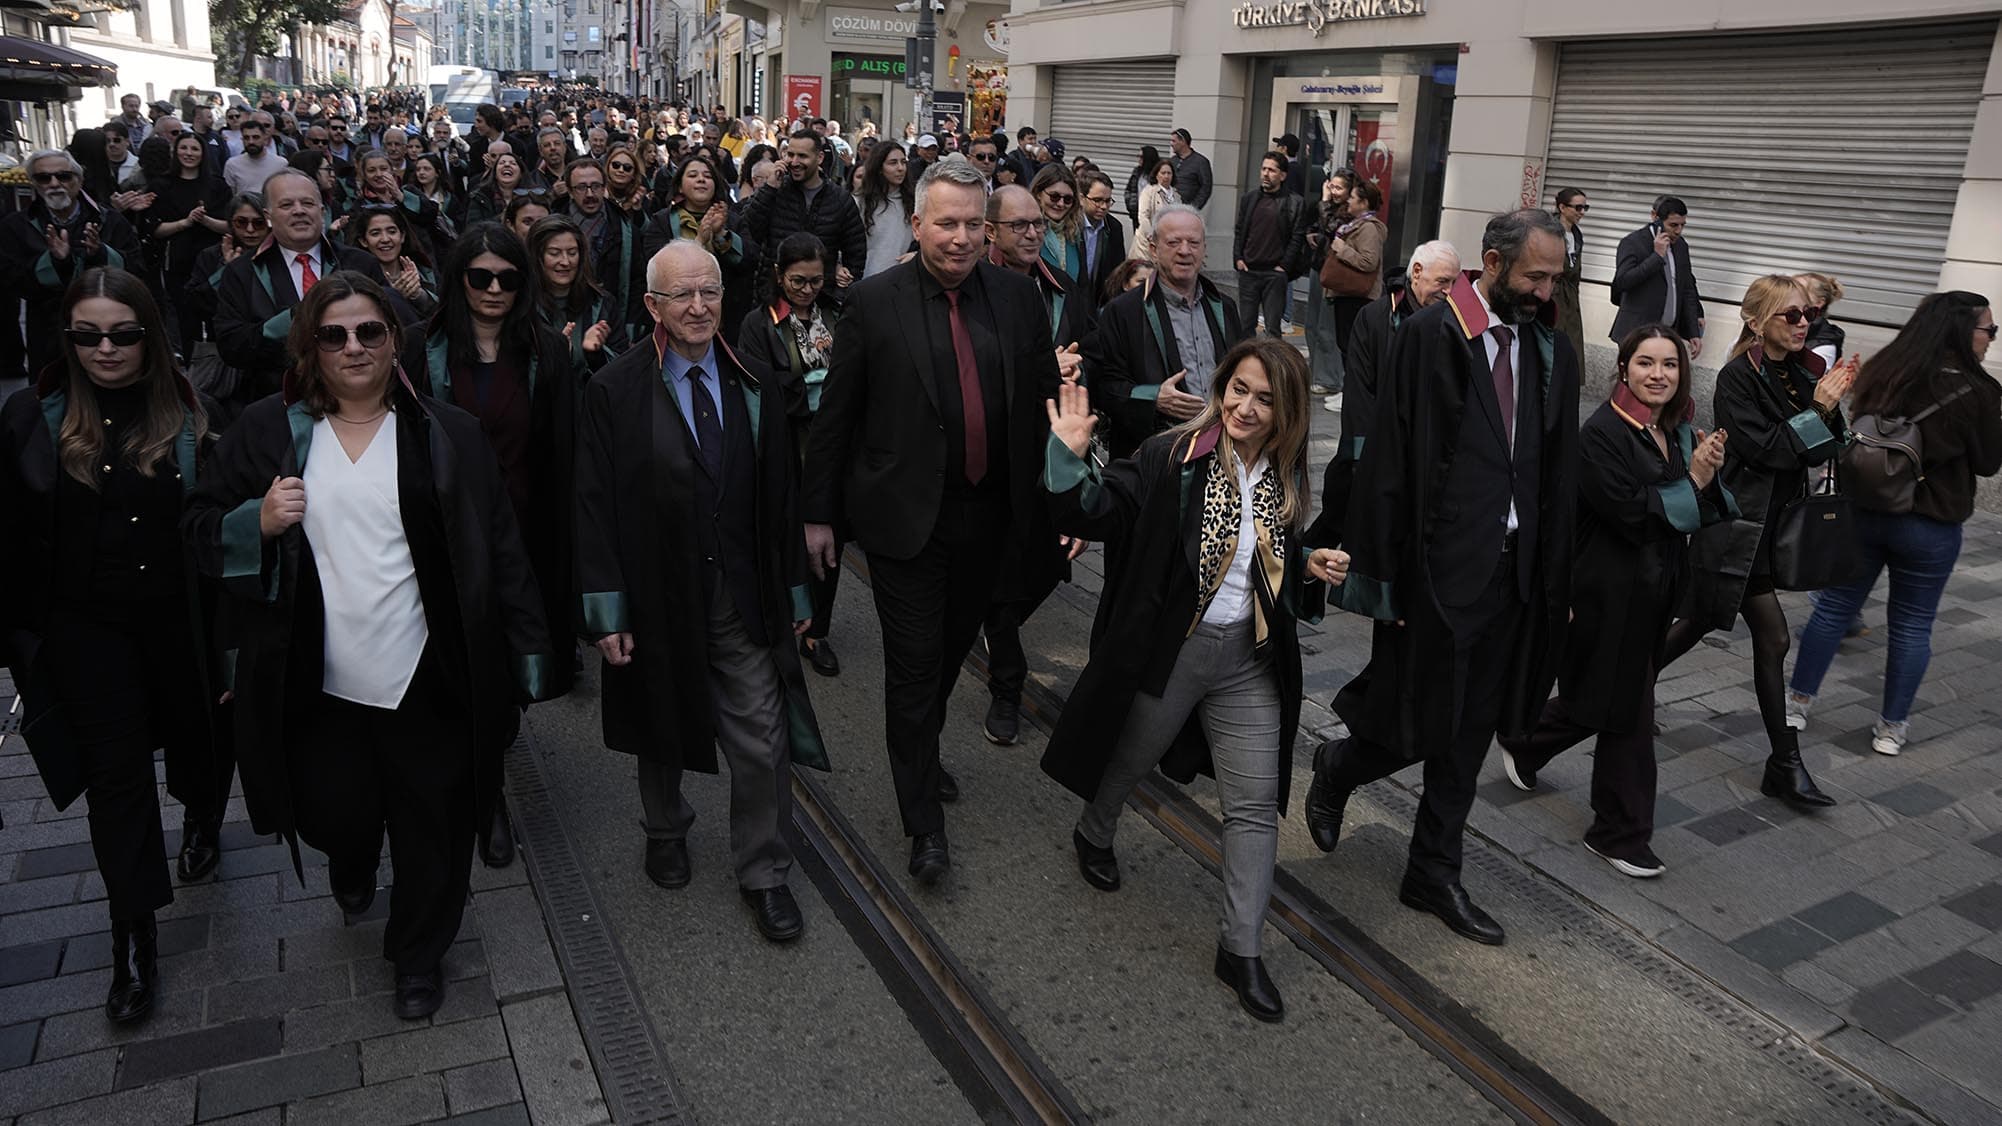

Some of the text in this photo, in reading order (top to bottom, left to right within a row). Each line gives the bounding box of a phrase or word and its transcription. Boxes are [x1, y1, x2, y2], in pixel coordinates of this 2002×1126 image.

[1231, 0, 1306, 26] TÜRKİYE
[832, 16, 918, 33] ÇÖZÜM DÖVİ
[860, 60, 890, 75] ALIŞ
[892, 62, 906, 75] (B
